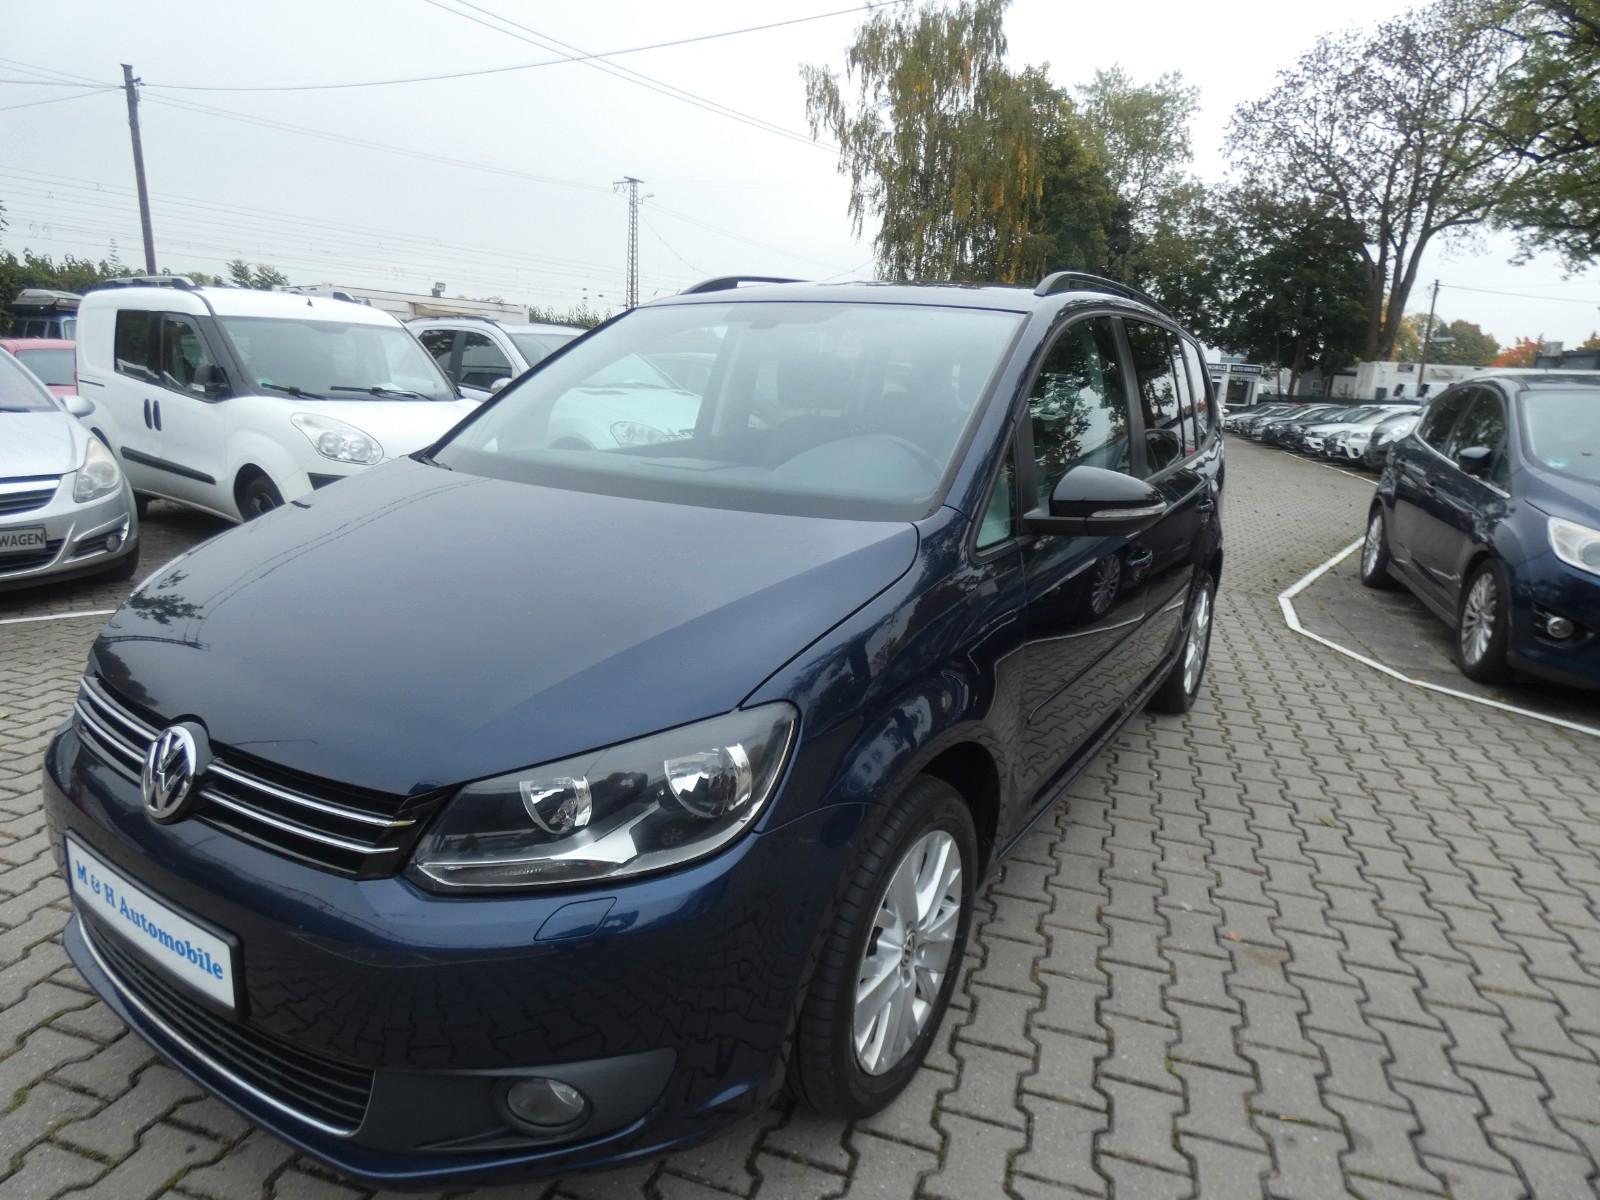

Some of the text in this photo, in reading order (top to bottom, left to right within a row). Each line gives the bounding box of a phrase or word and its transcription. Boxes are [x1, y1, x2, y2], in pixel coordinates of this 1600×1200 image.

[76, 860, 88, 885] M
[91, 874, 101, 895] &
[120, 896, 224, 980] Automobile
